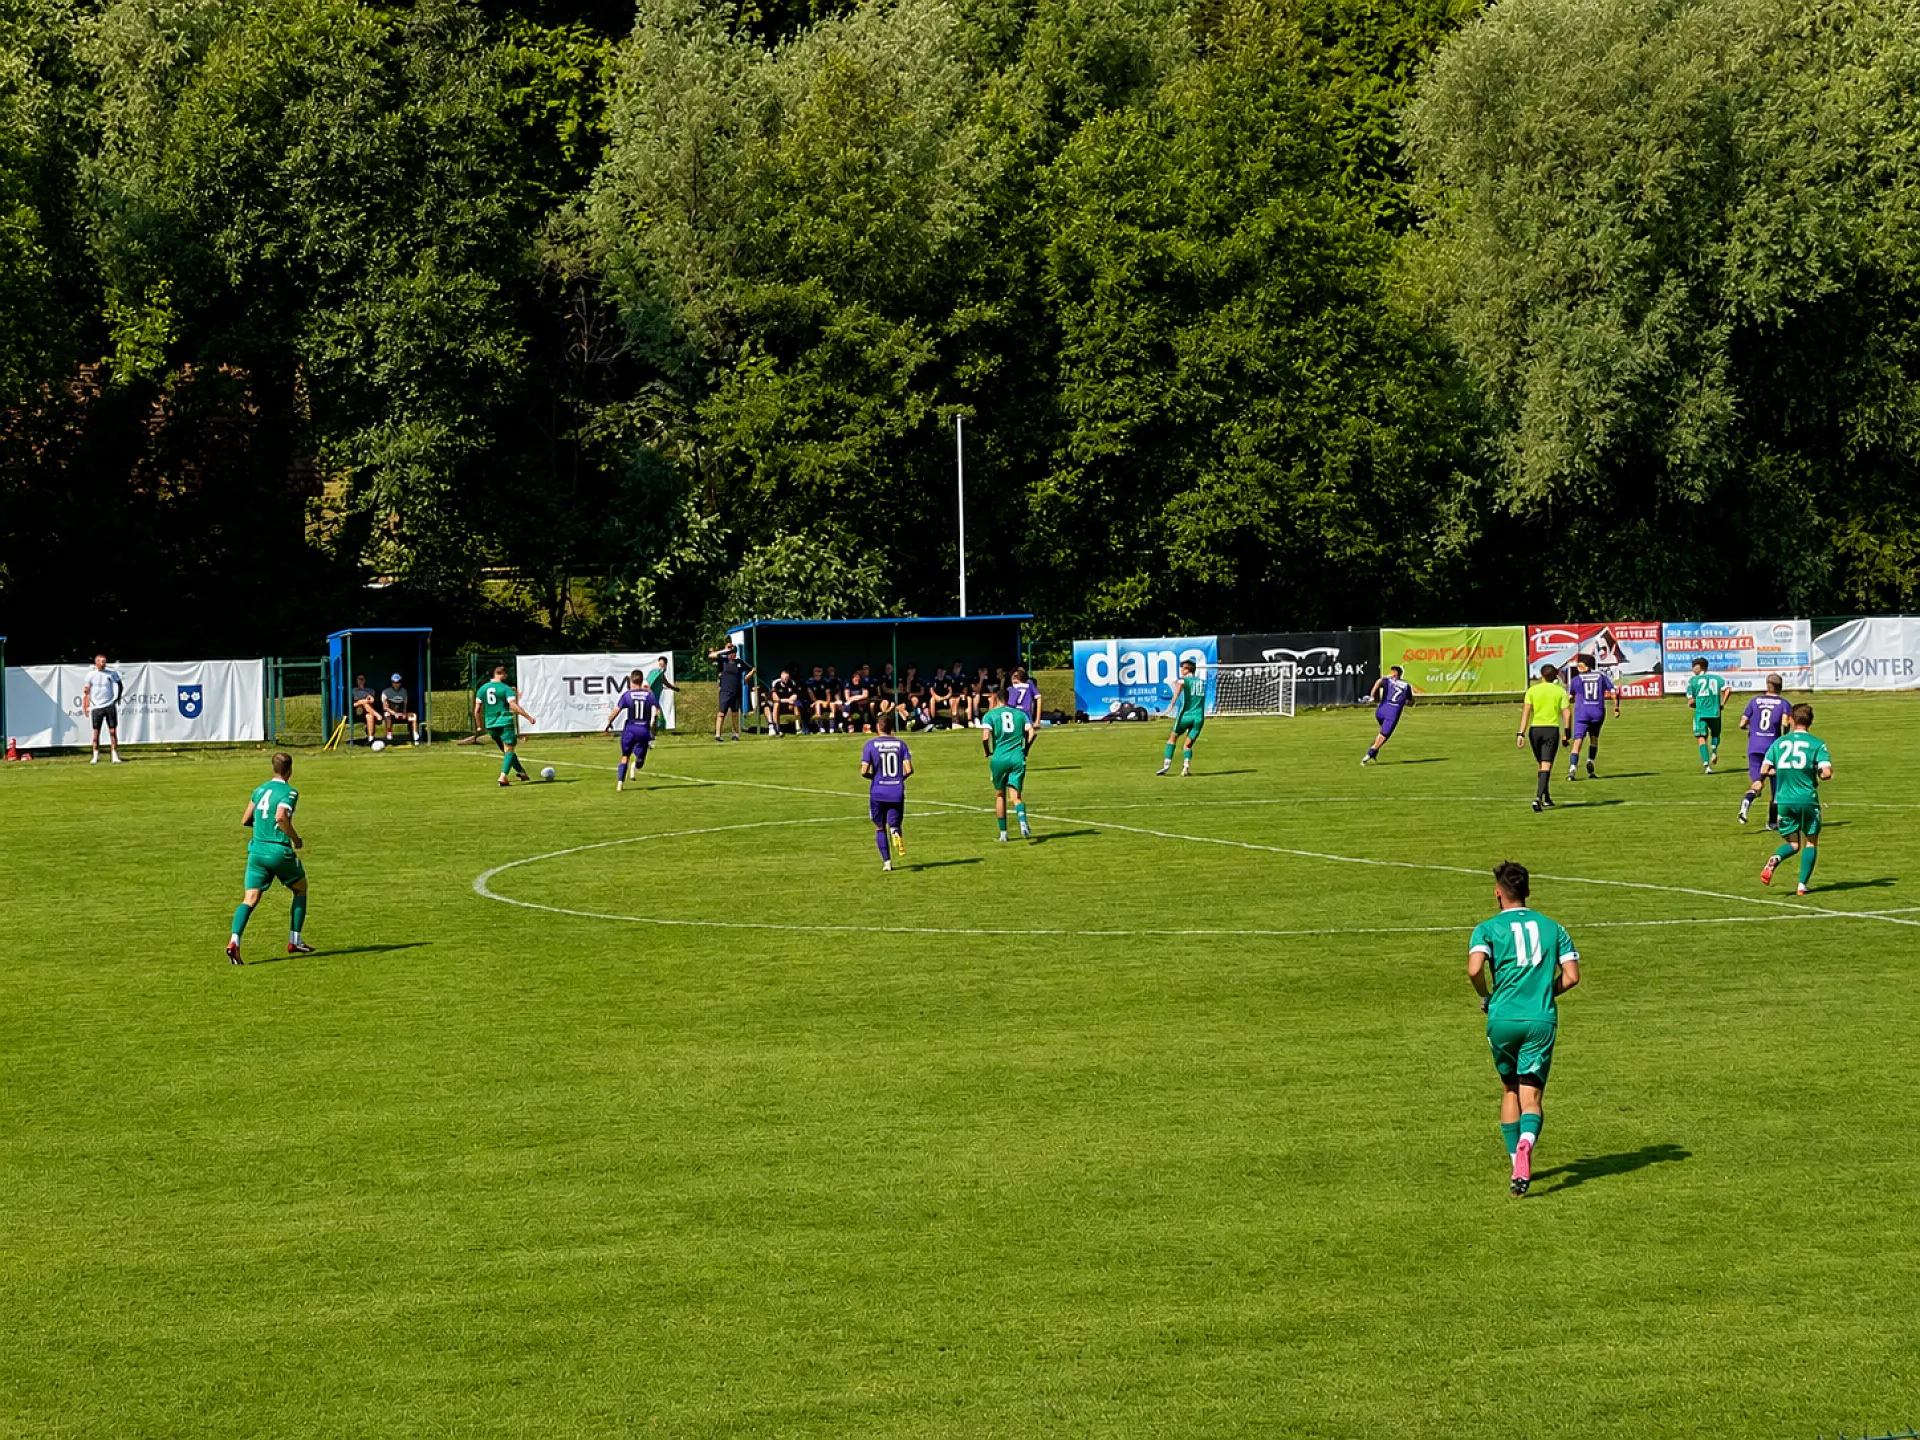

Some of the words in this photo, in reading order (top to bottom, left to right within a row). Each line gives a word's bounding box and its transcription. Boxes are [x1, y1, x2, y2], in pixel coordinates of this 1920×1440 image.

[486, 687, 496, 705] 6
[1016, 689, 1026, 704] 7
[1391, 686, 1402, 702] 7
[634, 700, 645, 719] 11
[1759, 709, 1772, 731] 8
[1001, 712, 1014, 733] 8
[880, 752, 898, 778] 10
[1778, 740, 1809, 769] 25
[257, 789, 273, 819] 4
[1510, 920, 1542, 966] 11
